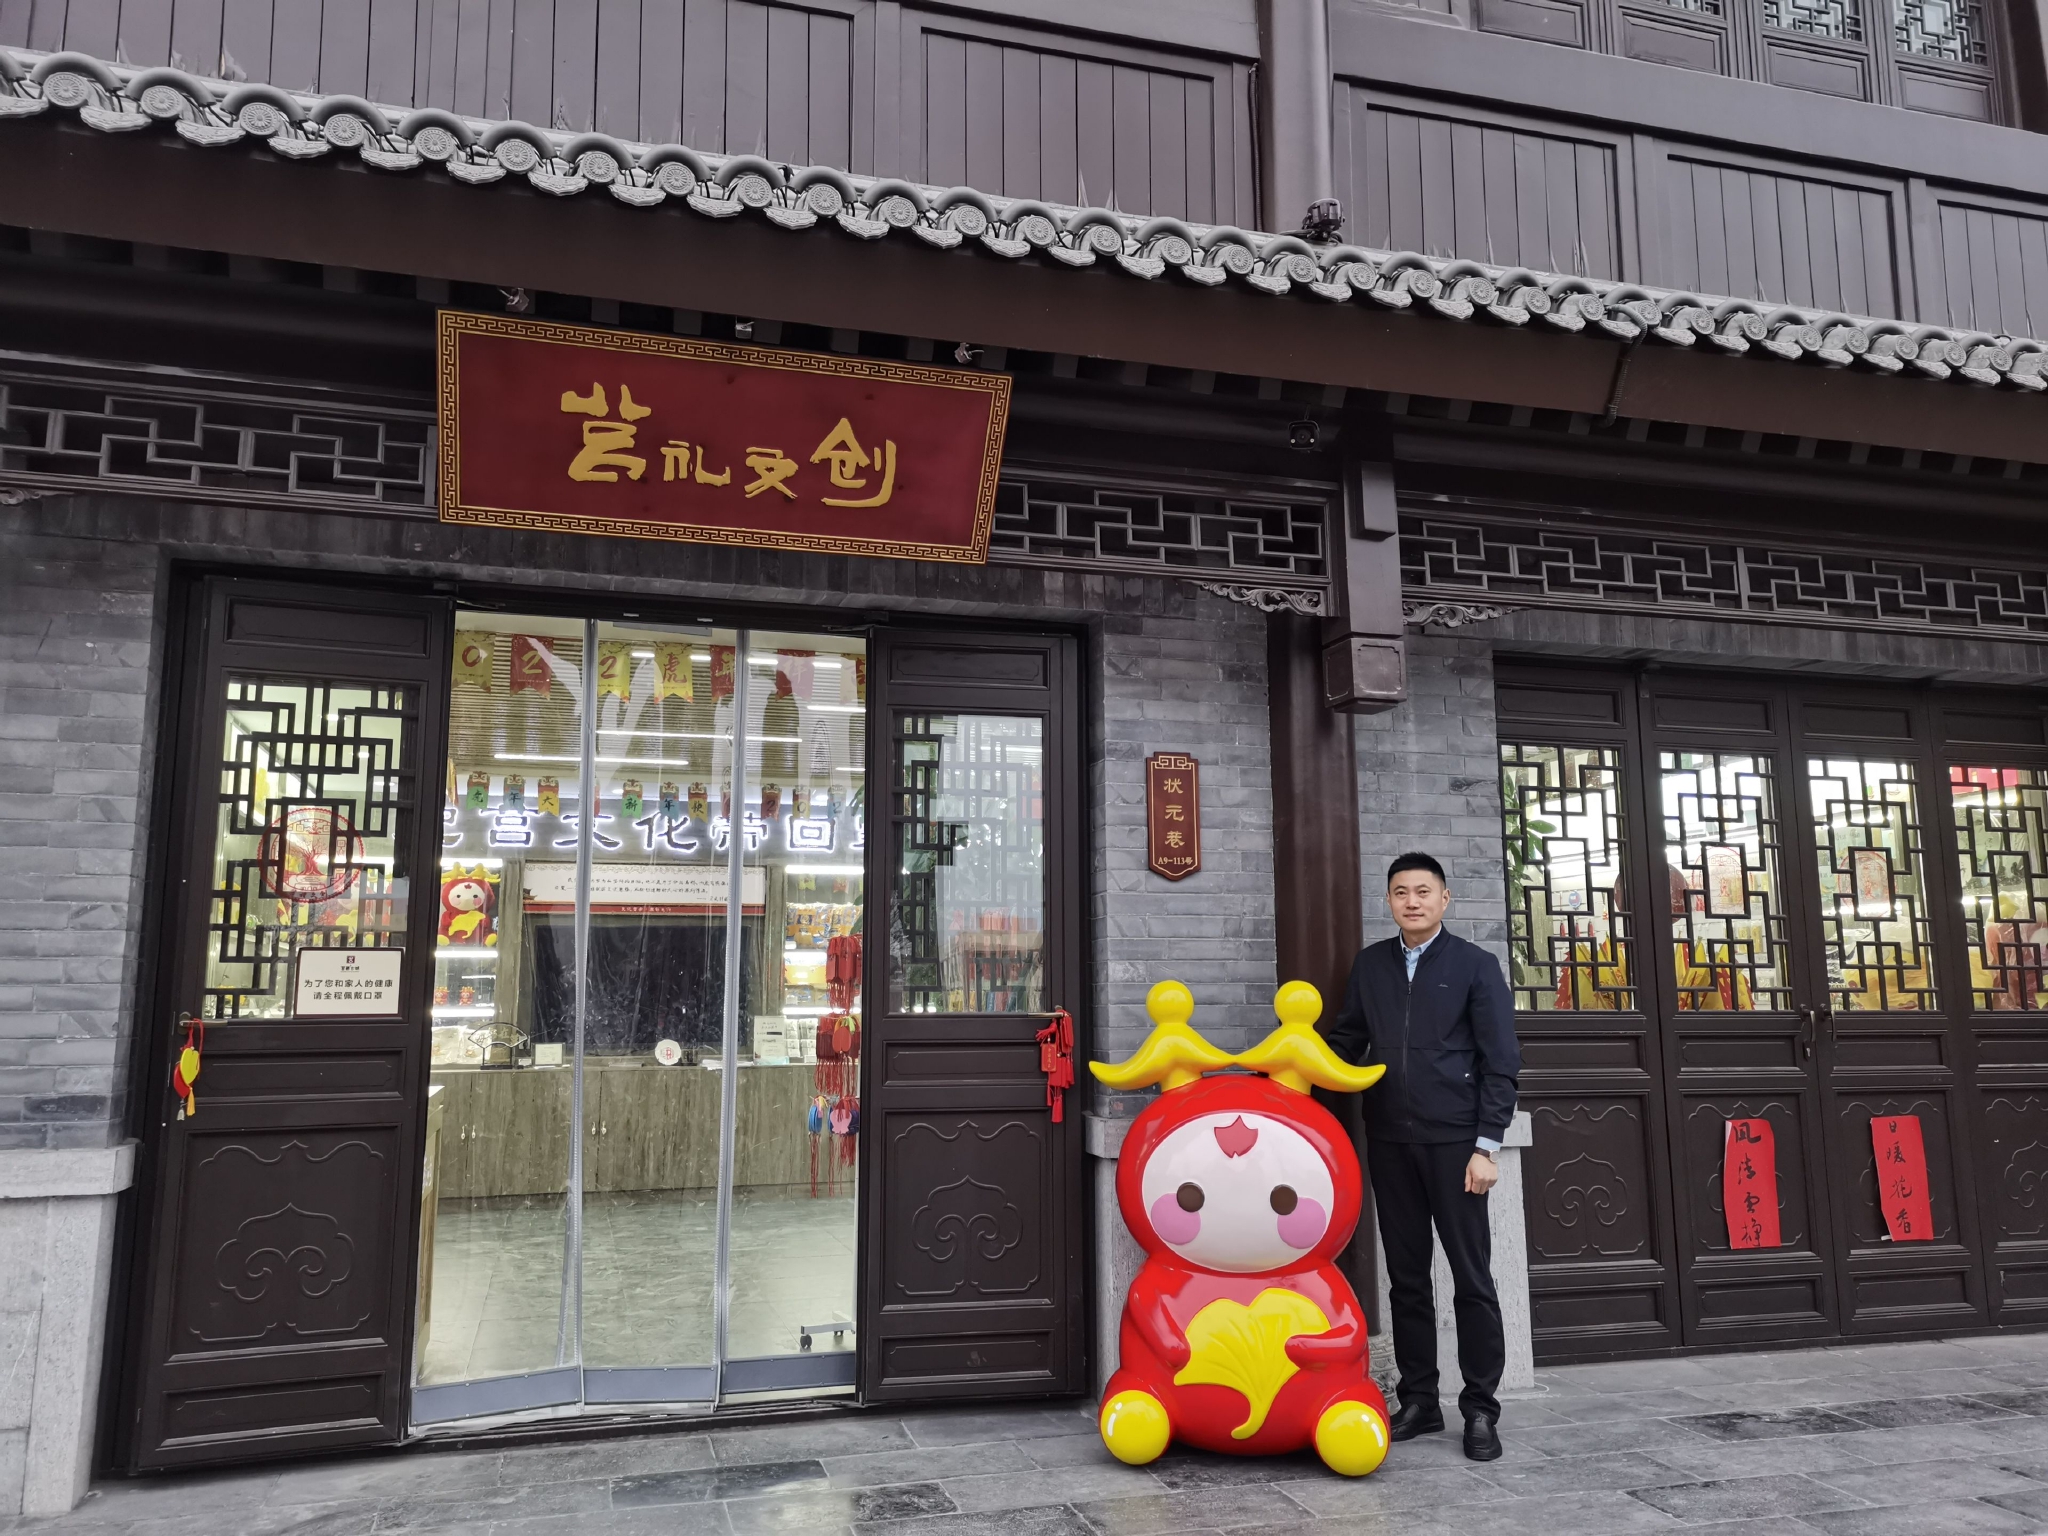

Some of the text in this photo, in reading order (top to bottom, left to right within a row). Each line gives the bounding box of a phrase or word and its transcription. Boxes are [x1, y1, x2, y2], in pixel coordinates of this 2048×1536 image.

[1163, 778, 1185, 849] 状元巷
[304, 979, 393, 988] 为了您和家人的健康
[313, 991, 383, 1000] 请全程佩戴口罩
